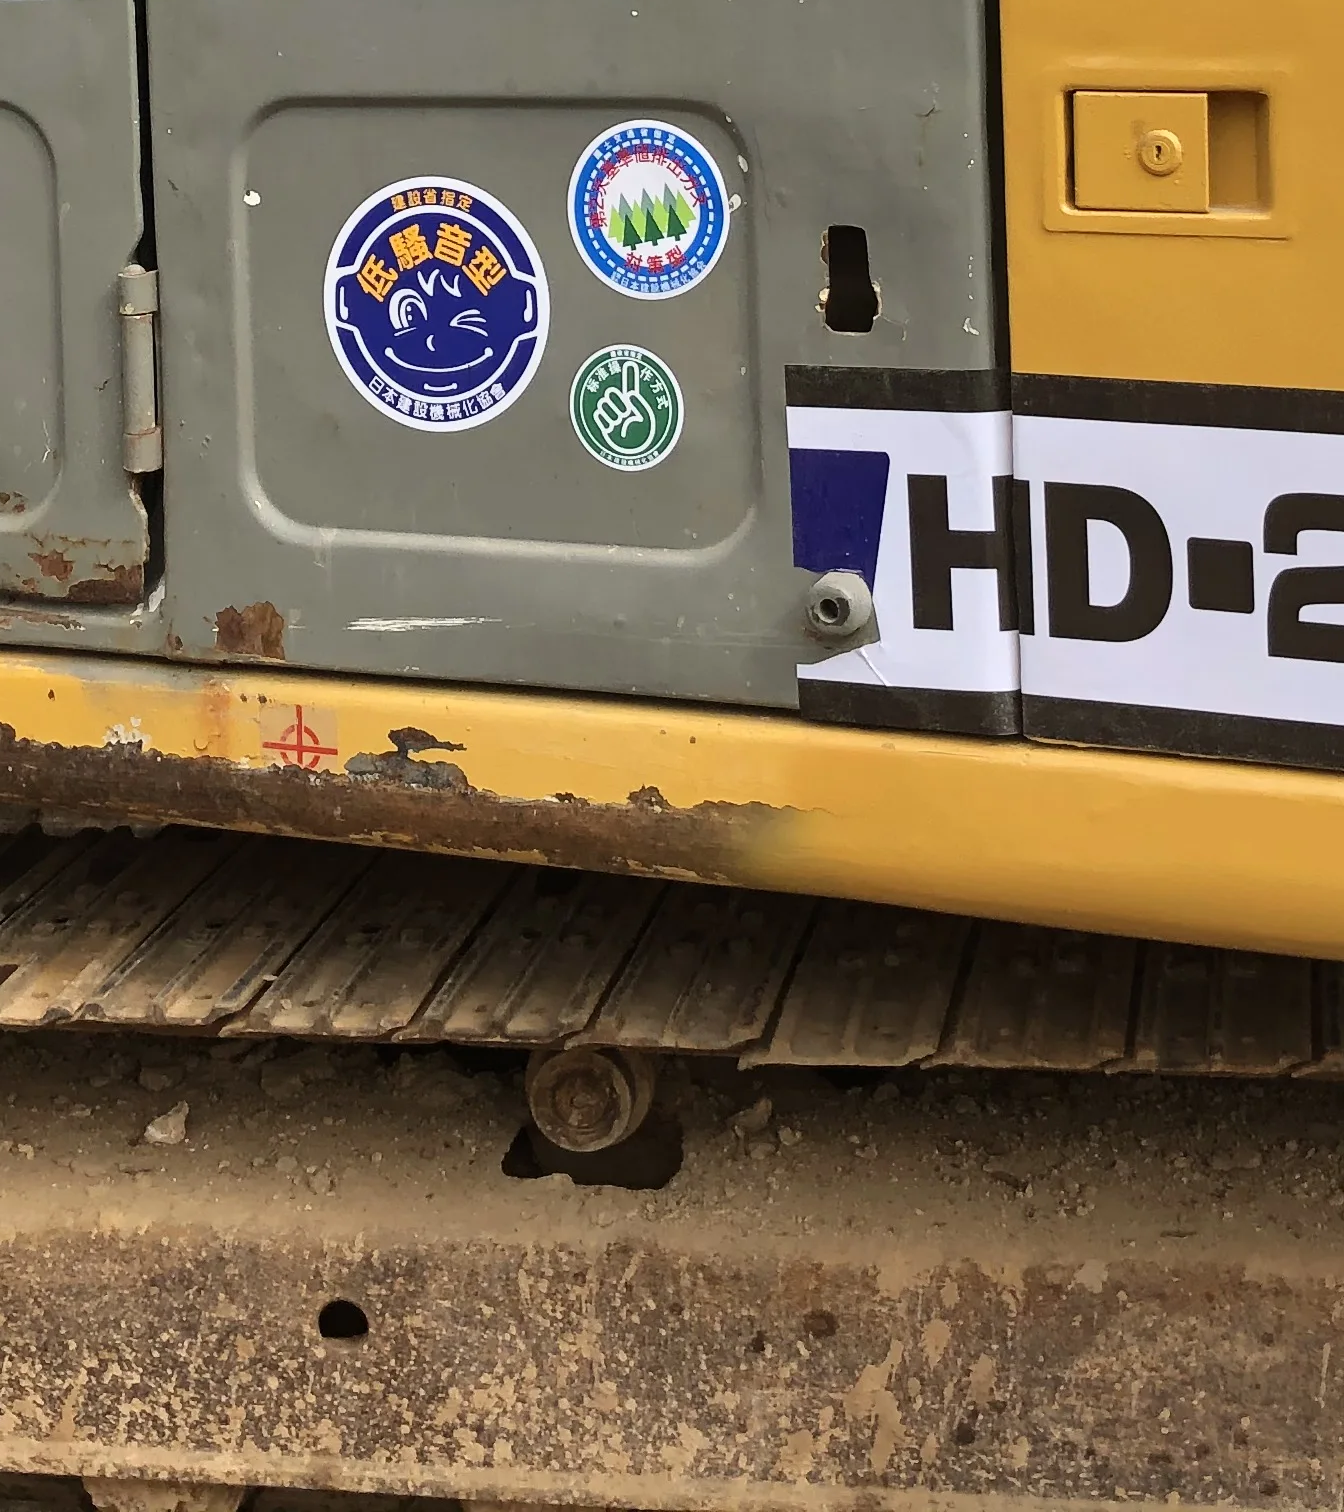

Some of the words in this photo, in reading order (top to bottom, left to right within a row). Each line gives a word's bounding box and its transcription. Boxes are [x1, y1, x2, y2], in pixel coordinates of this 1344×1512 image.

[391, 187, 473, 213] 建設省指定
